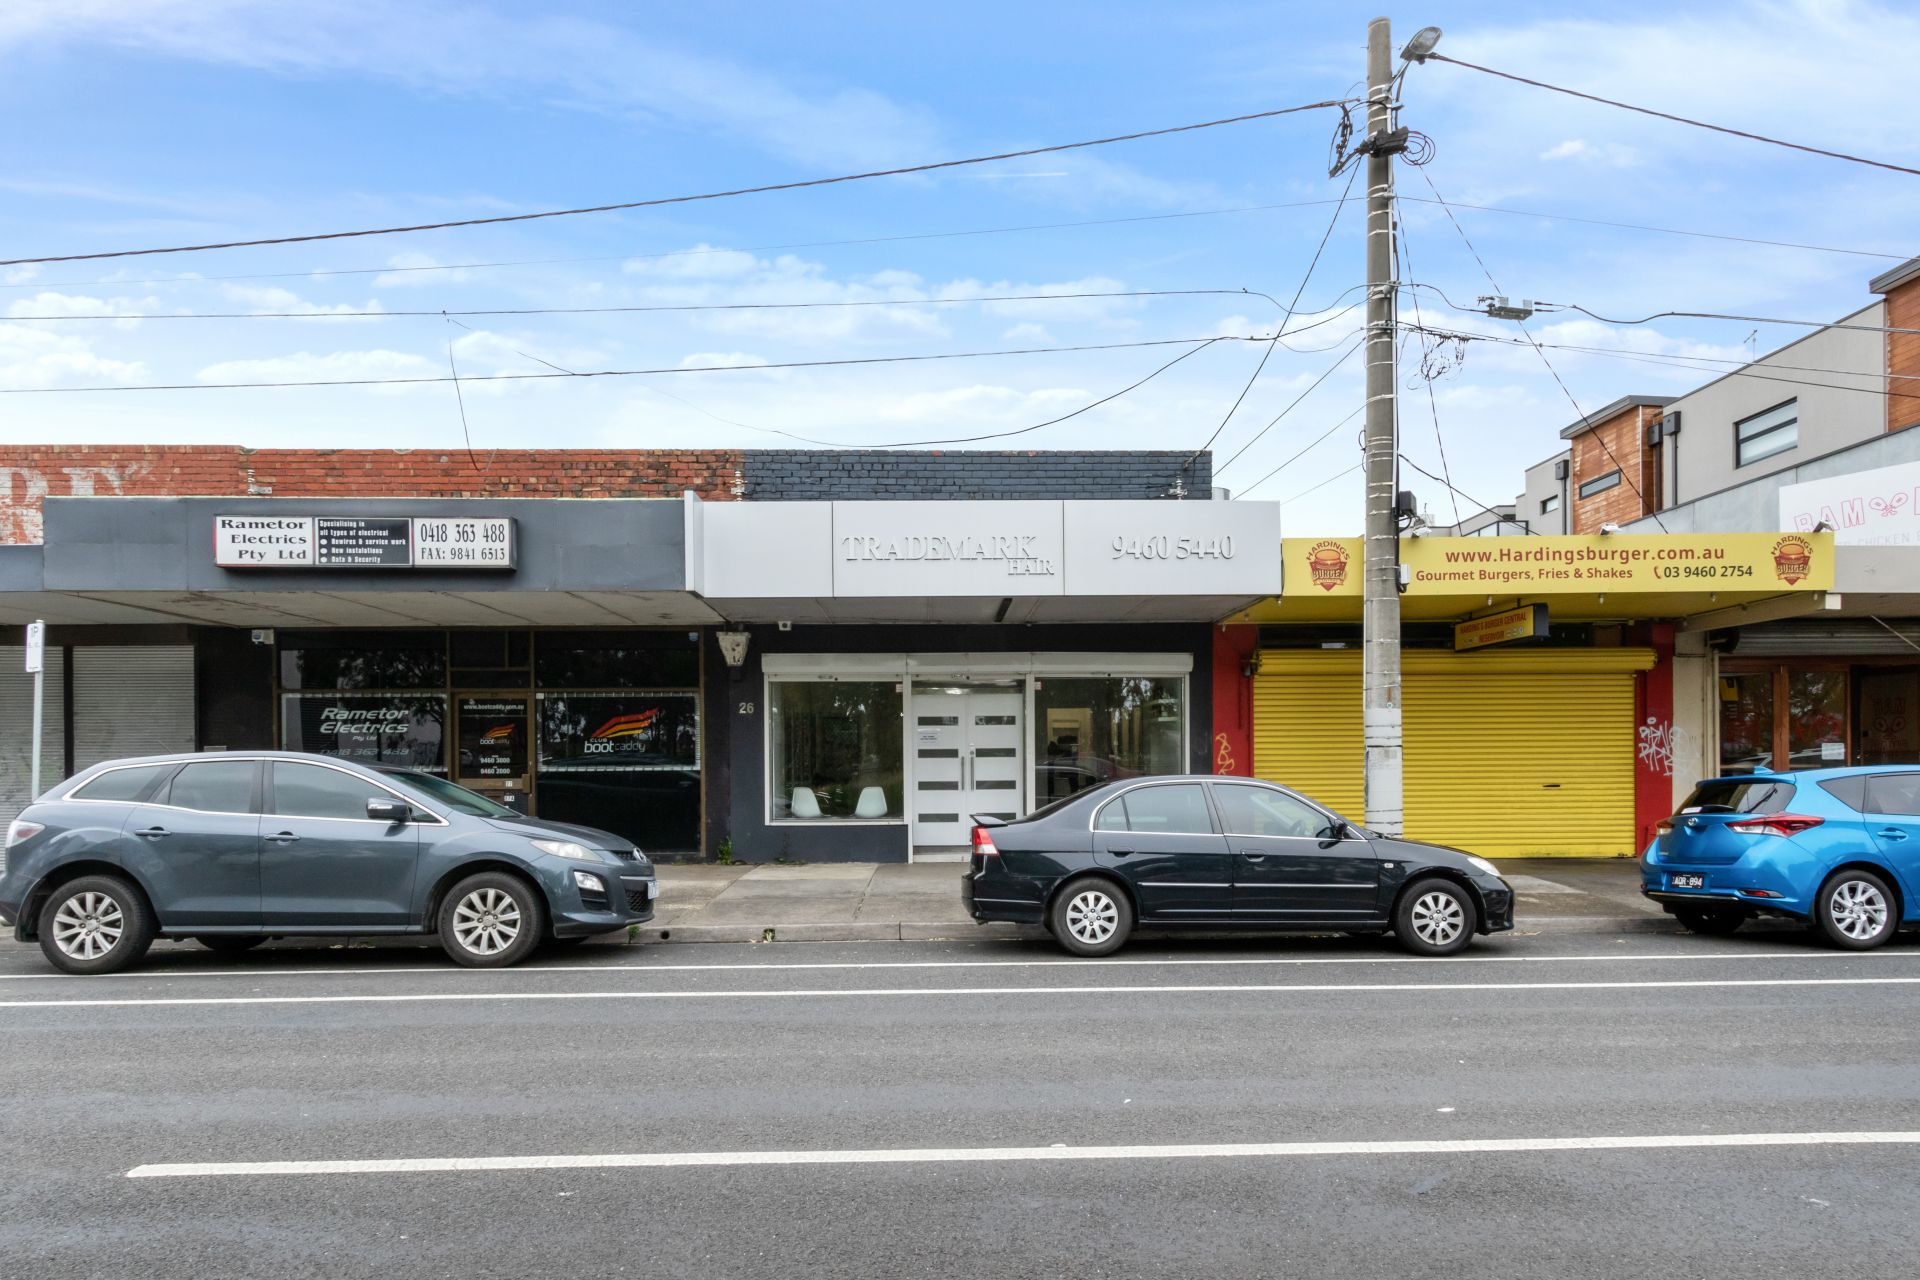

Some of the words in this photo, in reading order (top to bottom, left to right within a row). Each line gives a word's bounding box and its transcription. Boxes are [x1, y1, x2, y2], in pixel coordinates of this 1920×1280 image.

[221, 519, 307, 529] Rametor
[231, 534, 307, 544] Electrics
[420, 522, 448, 542] 0418
[454, 523, 476, 543] 363
[483, 522, 505, 543] 488
[842, 535, 1038, 561] TRADEMARK
[1111, 535, 1170, 560] 9460
[1175, 535, 1236, 560] 5440
[1306, 540, 1351, 561] HARDINGS
[1771, 535, 1814, 556] HARDINGS
[238, 549, 266, 562] Pty
[279, 549, 306, 560] Ltd
[421, 547, 446, 560] FAX:
[450, 547, 475, 560] 9841
[481, 548, 505, 560] 6513
[1445, 546, 1725, 565] www.Hardingsburger.com.au
[1007, 560, 1055, 576] HAIR
[1416, 570, 1475, 581] Gourmet
[1478, 569, 1534, 583] Burgers,
[1538, 568, 1570, 580] Fries
[1573, 568, 1583, 579] &
[1587, 567, 1633, 579] Shakes
[1663, 566, 1680, 578] 03
[1684, 566, 1716, 578] 9460
[1720, 565, 1753, 577] 2754
[320, 707, 409, 719] Rametor
[739, 702, 754, 714] 26
[319, 721, 409, 733] Electrics
